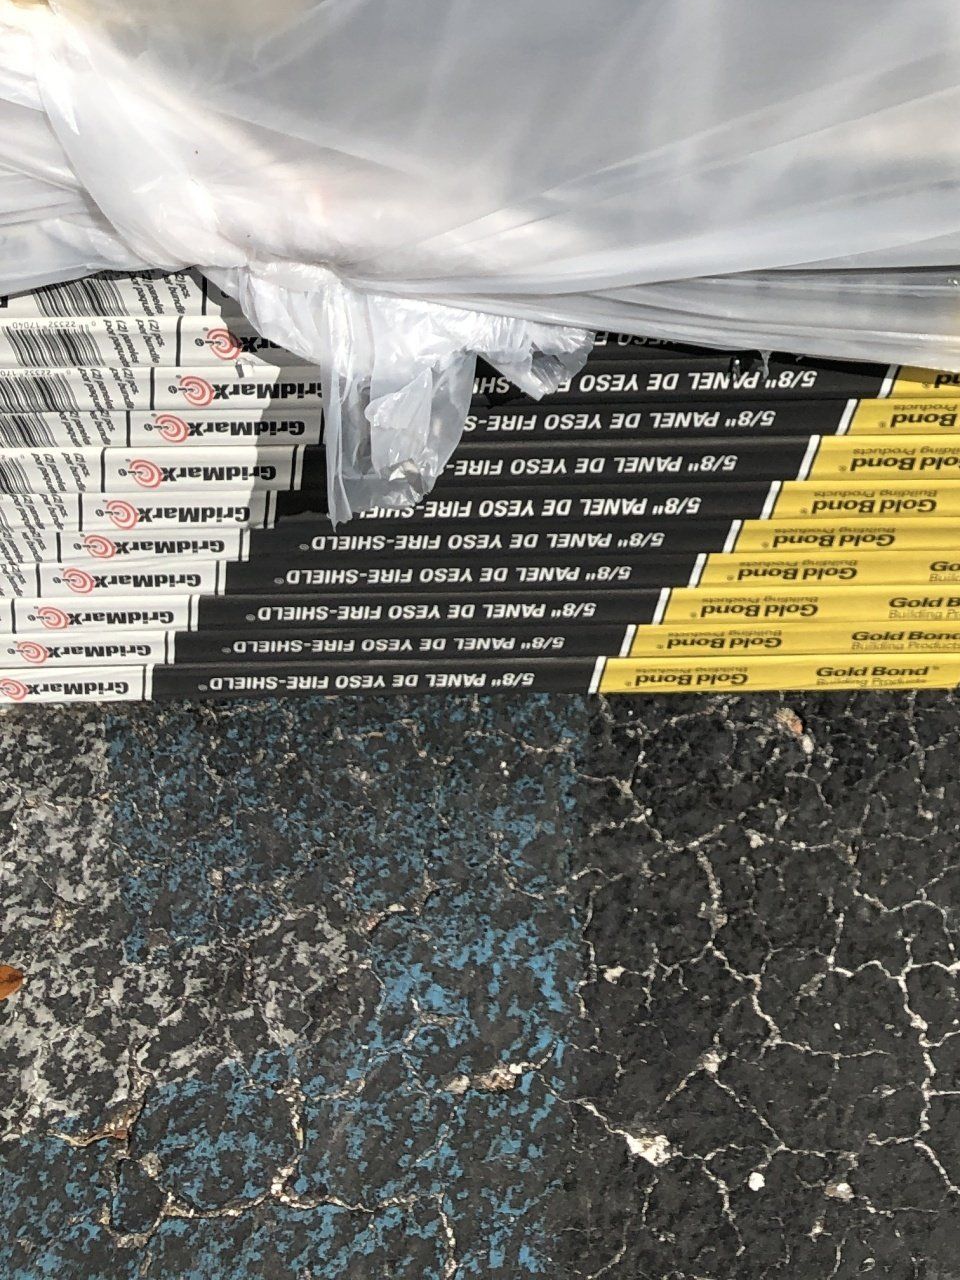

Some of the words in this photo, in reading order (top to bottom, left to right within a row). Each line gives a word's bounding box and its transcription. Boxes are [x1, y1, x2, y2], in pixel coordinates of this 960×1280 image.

[579, 374, 639, 392] YESO
[646, 373, 678, 391] DE
[688, 371, 761, 390] PANEL
[765, 370, 818, 389] 5/8"
[543, 413, 602, 431] YESO
[609, 413, 641, 430] DE
[650, 411, 721, 430] PANEL
[725, 410, 777, 428] 5/8"
[890, 411, 957, 428] Bond
[188, 419, 306, 437] GridMarX
[510, 458, 568, 476] YESO
[575, 457, 605, 474] DE
[613, 456, 683, 473] PANEL
[687, 454, 739, 472] 5/8"
[849, 456, 916, 472] Bond
[160, 464, 277, 483] GridMarX
[478, 500, 535, 517] YESO
[541, 499, 571, 516] DE
[580, 498, 648, 516] PANEL
[652, 496, 702, 515] 5/8"
[812, 499, 876, 515] Bond
[879, 498, 938, 514] Gold
[137, 505, 251, 524] GridMarX
[114, 539, 226, 556] GridMarX
[448, 534, 503, 551] YESO
[509, 533, 539, 549] DE
[546, 532, 613, 549] PANEL
[617, 531, 666, 549] 5/8"
[773, 534, 836, 548] Bond
[838, 533, 896, 548] Gold
[93, 573, 202, 589] GridMarX
[419, 568, 473, 584] YESO
[479, 567, 508, 583] DE
[515, 566, 581, 583] PANEL
[585, 565, 633, 582] 5/8"
[447, 603, 476, 619] DE
[481, 602, 547, 619] PANEL
[550, 601, 598, 618] 5/8"
[700, 603, 760, 618] Bond
[763, 602, 820, 617] Gold
[888, 596, 944, 609] Gold
[67, 610, 175, 627] GridMarX
[387, 604, 441, 620] YESO
[418, 637, 447, 652] DE
[453, 636, 515, 652] PANEL
[521, 635, 566, 652] 5/8"
[666, 636, 725, 650] Bond
[728, 636, 783, 650] Gold
[851, 630, 906, 642] Gold
[46, 644, 152, 659] GridMarX
[360, 638, 412, 653] YESO
[424, 672, 487, 688] PANEL
[490, 671, 536, 688] 5/8"
[635, 673, 693, 686] Bond
[695, 672, 749, 686] Gold
[816, 665, 869, 678] Gold
[871, 665, 929, 678] Bond
[26, 680, 130, 696] GridMarX
[334, 674, 387, 690] YESO
[391, 674, 418, 689] DE
